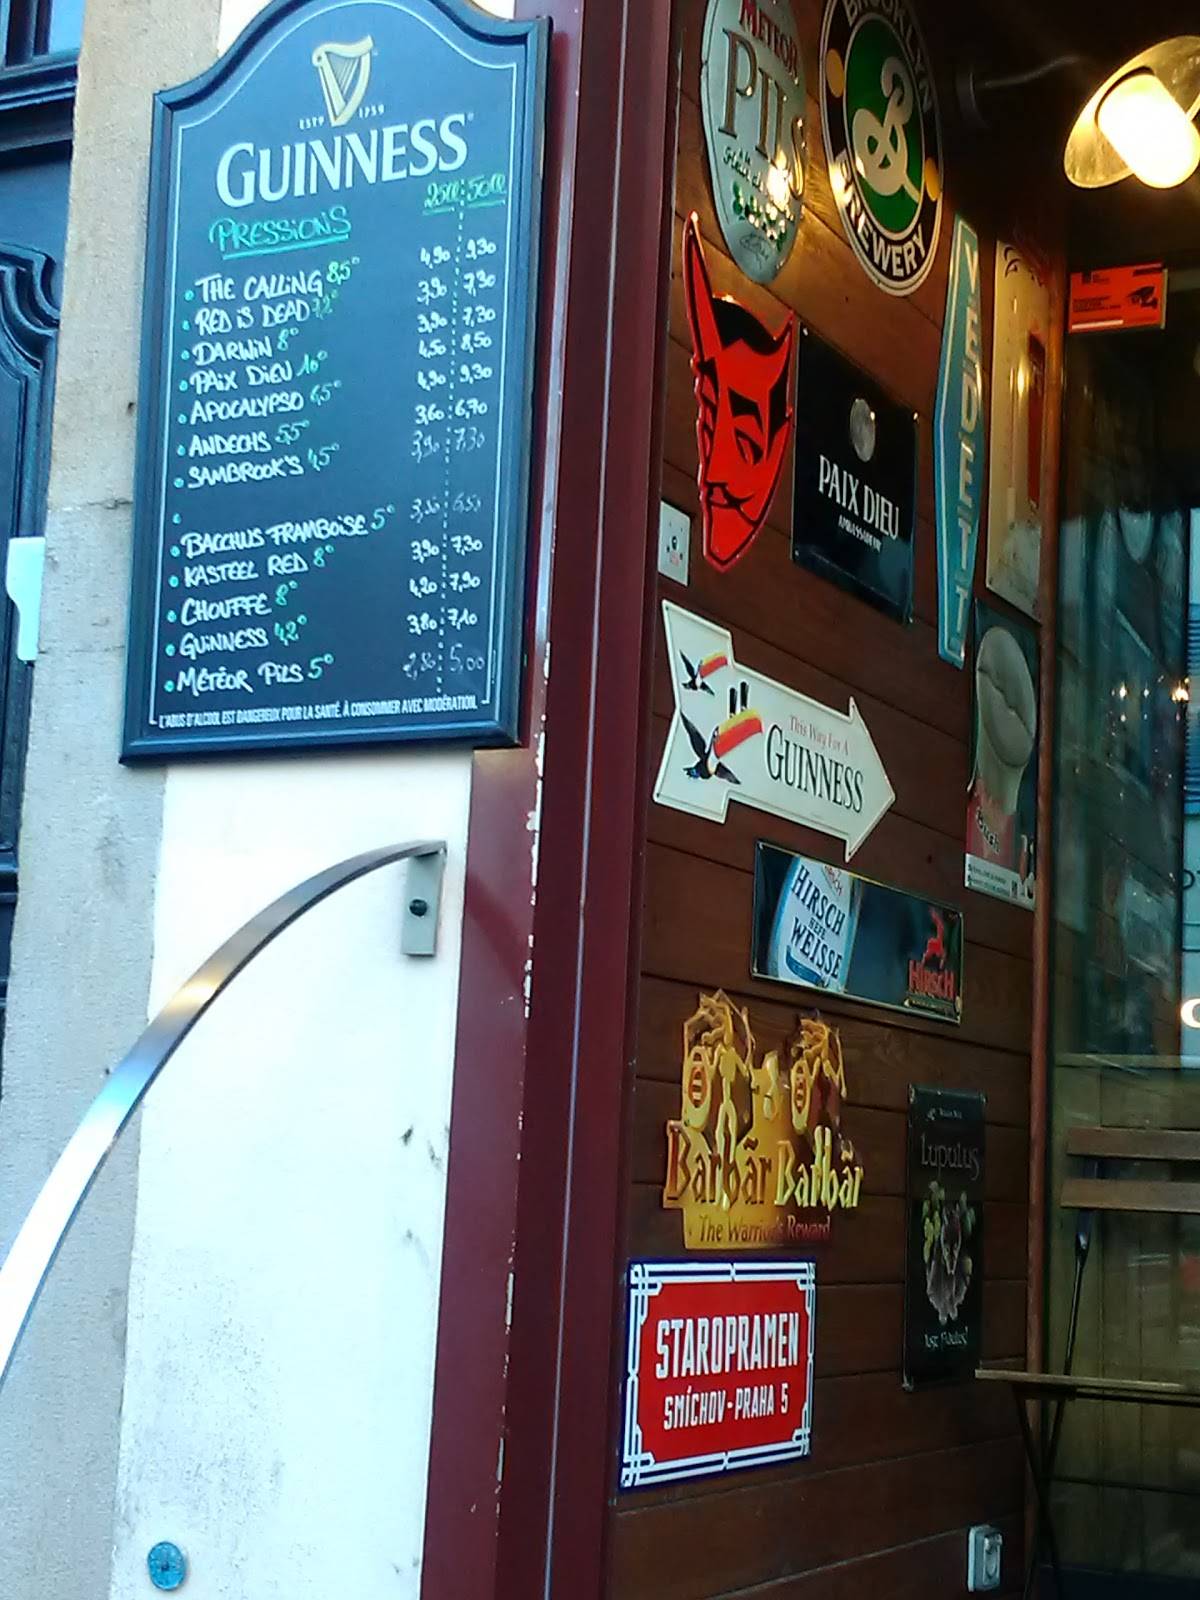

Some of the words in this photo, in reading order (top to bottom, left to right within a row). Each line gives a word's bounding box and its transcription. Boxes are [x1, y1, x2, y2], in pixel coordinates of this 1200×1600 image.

[216, 113, 468, 208] GUINNESS
[195, 273, 236, 303] THE
[195, 308, 232, 336] RED
[262, 299, 310, 327] DEAD
[190, 391, 305, 425] APOCALYPSO
[819, 455, 859, 516] PAIX
[863, 484, 899, 540] DIEU
[180, 528, 266, 559] BACCHUS
[184, 561, 260, 588] KASTEEL
[268, 552, 309, 576] RED
[181, 593, 273, 626] CHOUFFE
[222, 709, 236, 725] EST
[303, 704, 314, 720] LA
[402, 698, 423, 714] AVEC
[767, 724, 864, 813] GUINNESS
[792, 864, 846, 936] HIRSCH
[791, 916, 842, 979] WEISSE
[699, 1214, 723, 1242] The
[656, 1312, 799, 1379] STAROPRAMEN
[781, 1383, 789, 1414] 5
